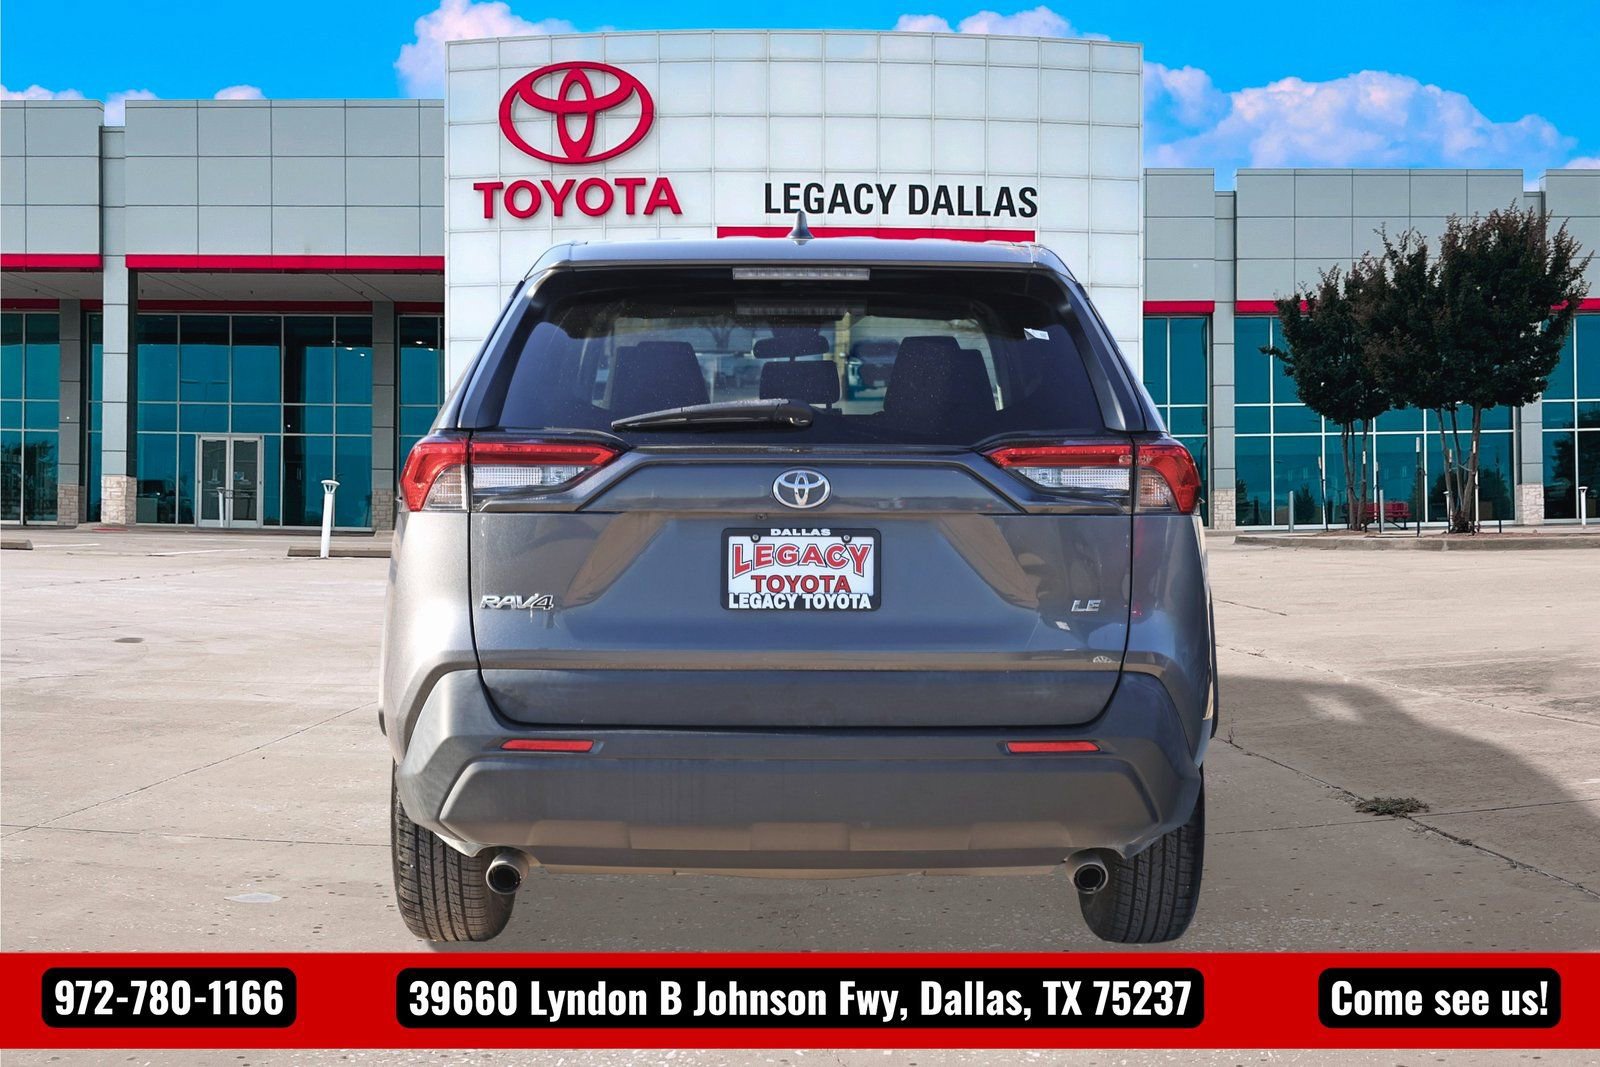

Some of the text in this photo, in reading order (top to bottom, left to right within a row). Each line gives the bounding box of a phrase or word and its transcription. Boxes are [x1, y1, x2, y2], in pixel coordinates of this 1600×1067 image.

[473, 176, 682, 219] TOYOTA
[765, 182, 1038, 218] LEGACY DALLAS
[770, 528, 831, 536] DALLAS
[732, 543, 872, 579] LEGACY
[751, 575, 852, 593] TOYOTA
[480, 593, 554, 610] RAV4
[728, 593, 872, 609] LEGACY TOYOTA
[1071, 599, 1102, 612] LE
